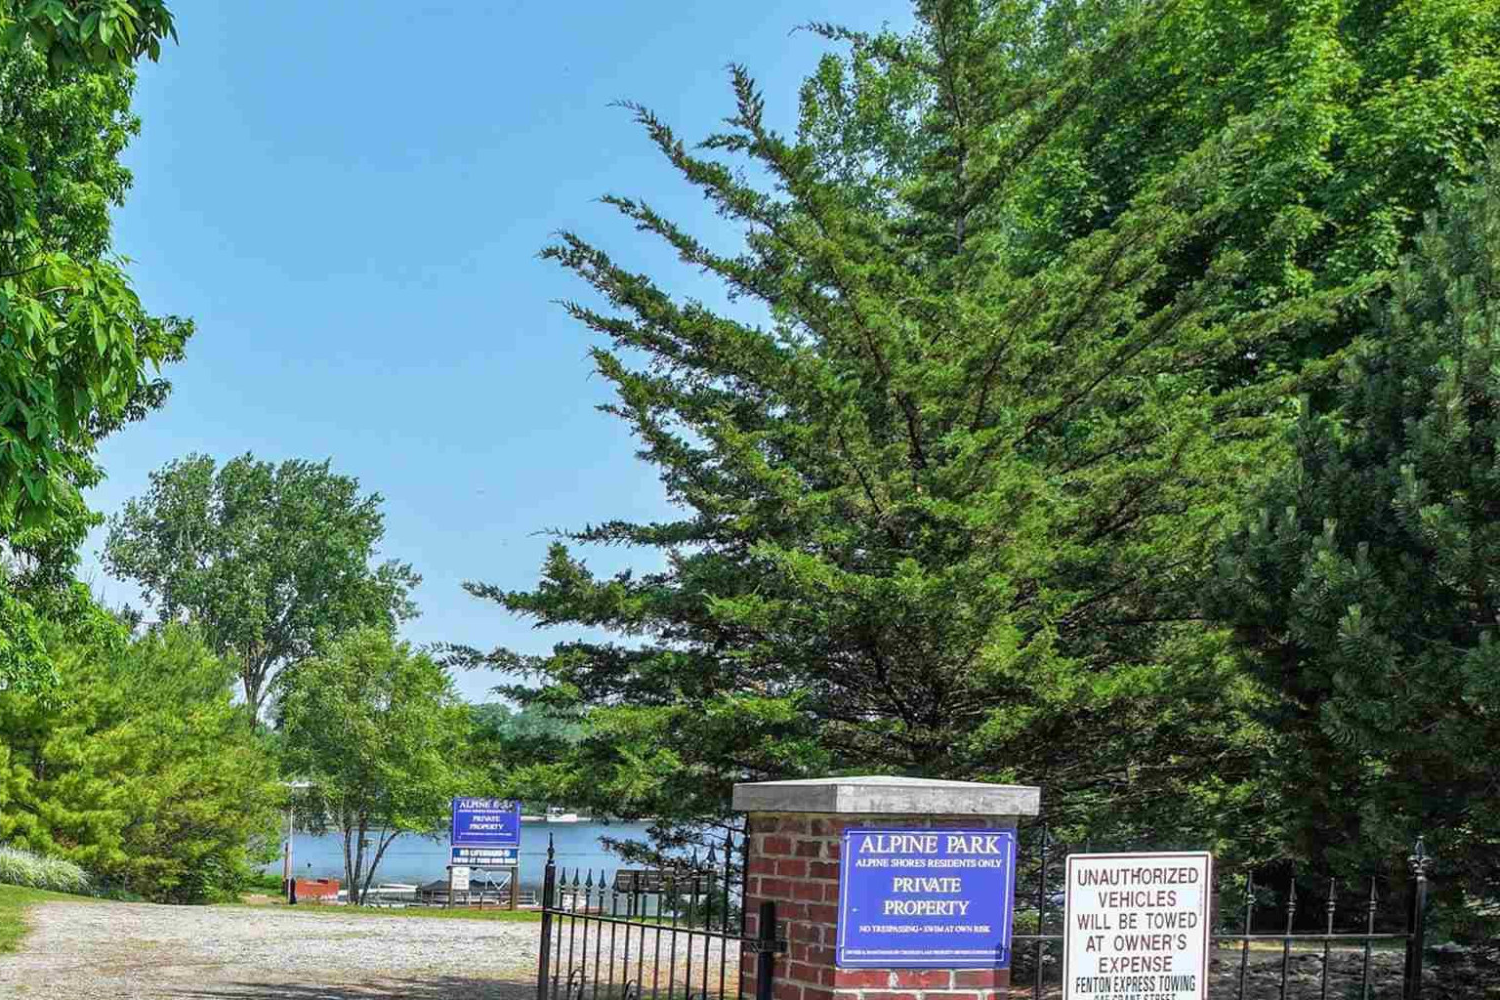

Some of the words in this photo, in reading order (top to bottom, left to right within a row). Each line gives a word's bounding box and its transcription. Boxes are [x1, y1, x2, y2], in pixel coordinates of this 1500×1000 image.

[859, 835, 938, 854] ALPINE
[946, 835, 1001, 854] PARK
[855, 858, 889, 868] ALPINE
[890, 858, 925, 868] SHORES
[927, 858, 976, 868] RESIDENTS
[977, 858, 1002, 868] ONLY
[892, 877, 962, 893] PRIVATE
[1077, 867, 1199, 886] UNAUTHORIZED
[882, 900, 969, 915] PROPERTY
[1098, 890, 1177, 908] VEHICLES
[1077, 914, 1111, 930] WILL
[1119, 913, 1137, 930] BE
[1146, 912, 1198, 929] TOWED
[1086, 936, 1105, 952] AT
[1113, 934, 1187, 951] OWNER'S
[1099, 956, 1173, 974] EXPENSE
[1076, 976, 1111, 993] FENTON
[1113, 976, 1156, 992] EXPRESS
[1159, 975, 1196, 992] TOWING
